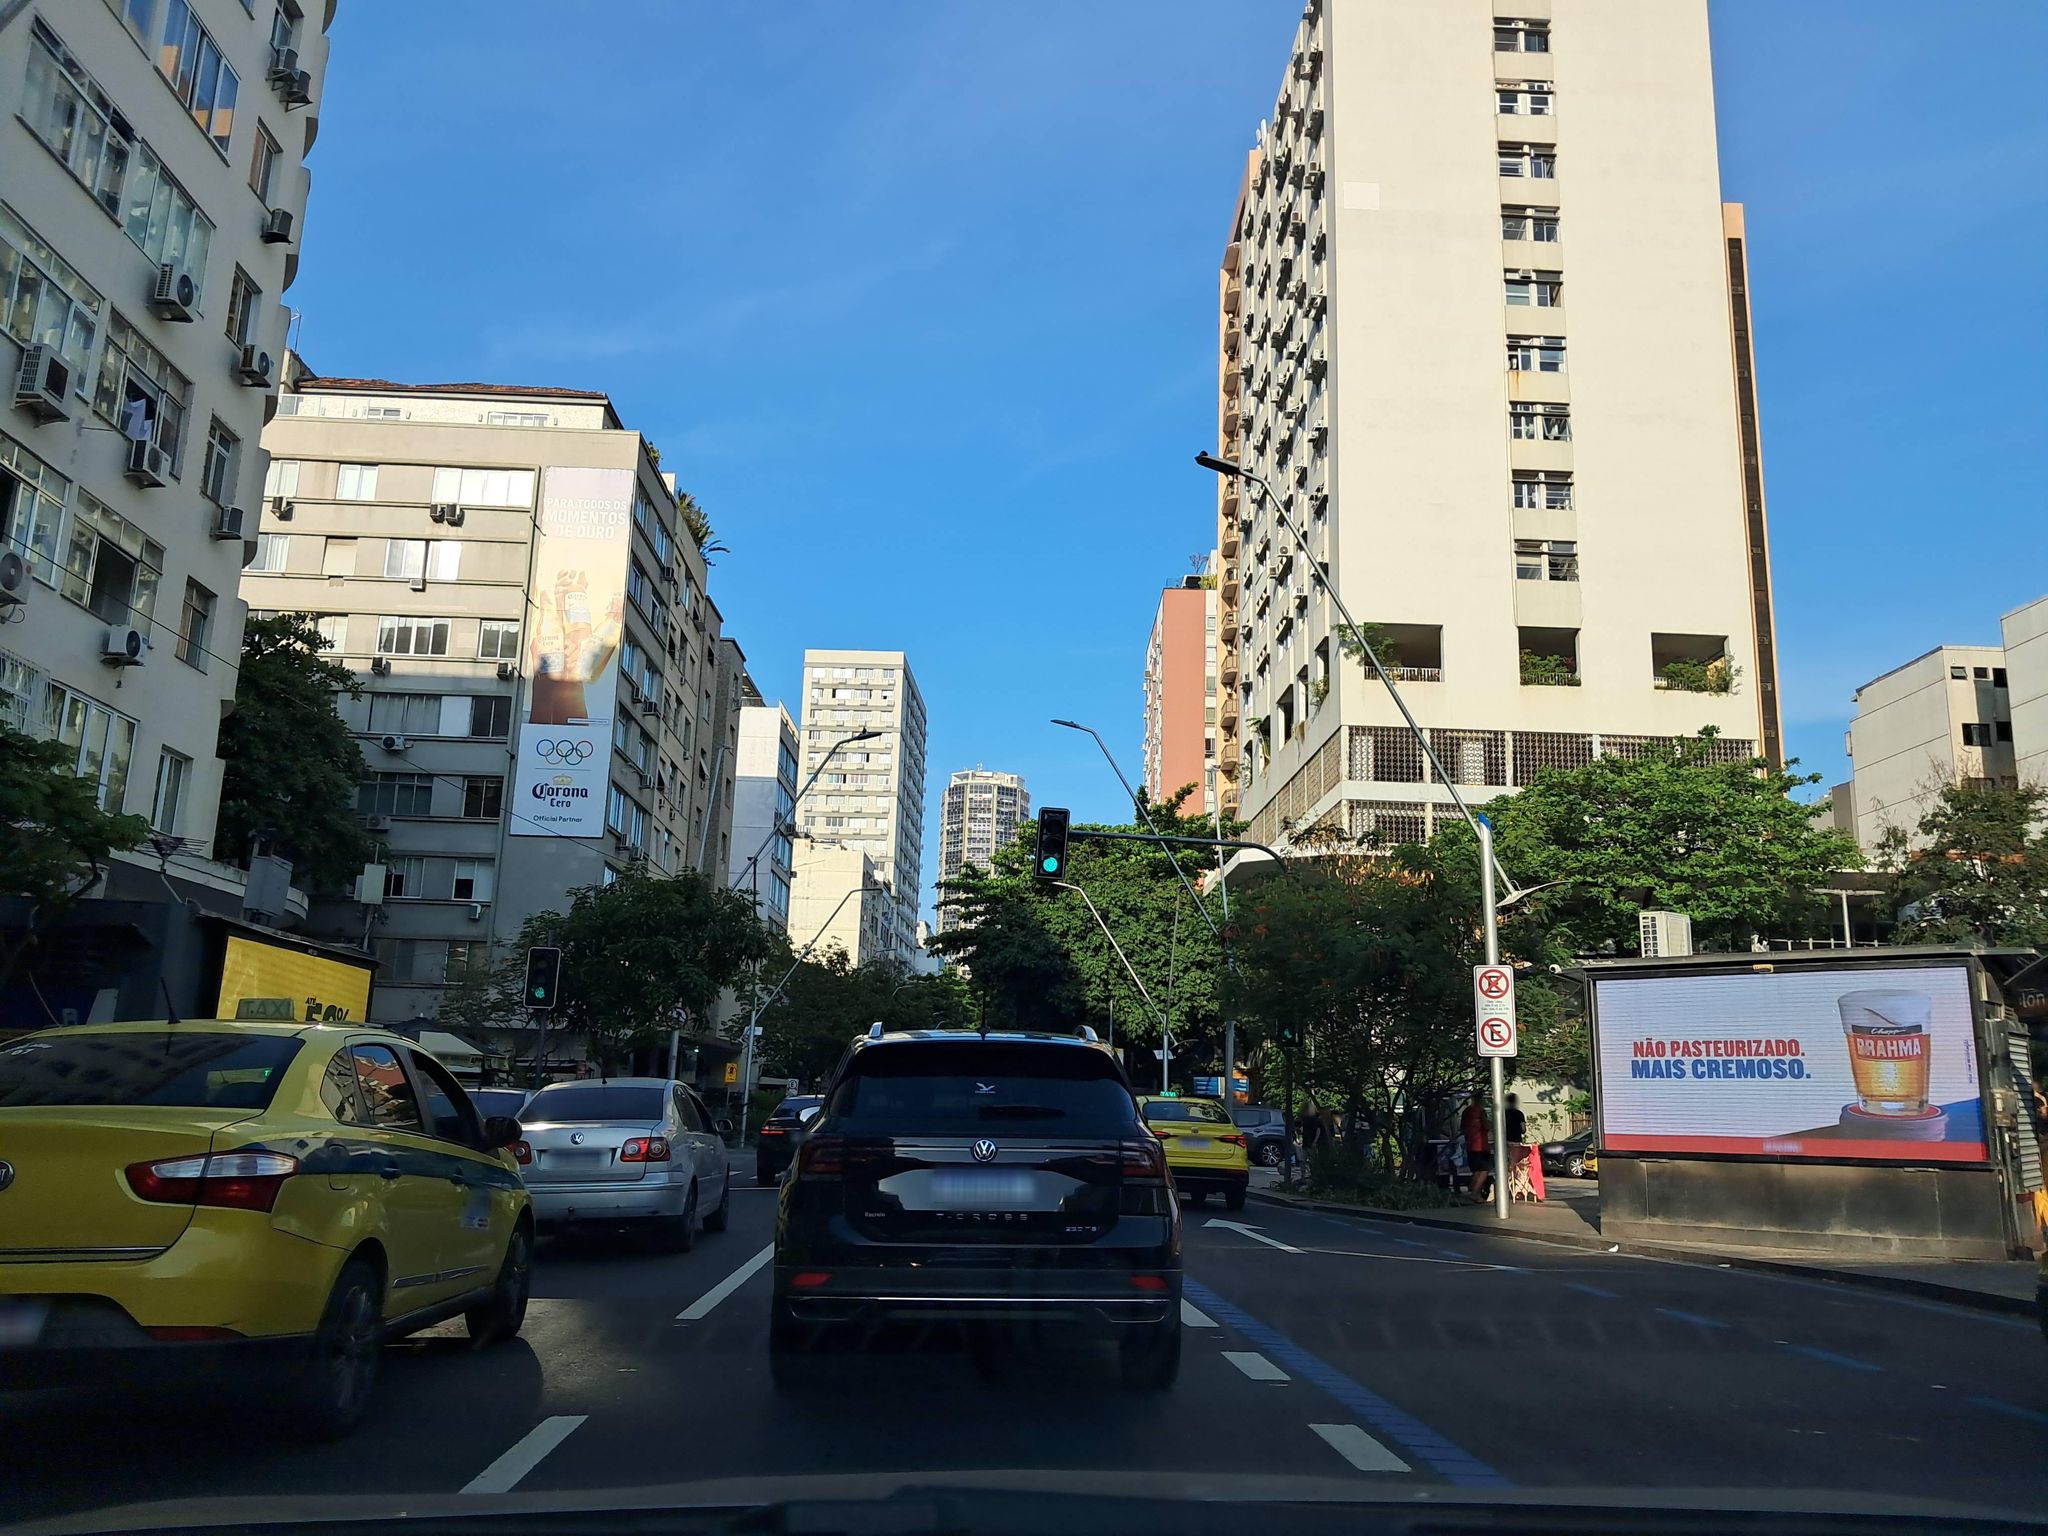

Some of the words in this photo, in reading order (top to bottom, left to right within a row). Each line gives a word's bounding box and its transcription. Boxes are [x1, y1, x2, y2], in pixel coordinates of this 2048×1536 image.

[547, 498, 574, 508] PARA
[577, 500, 610, 510] TODOS
[613, 500, 627, 511] OS
[545, 509, 626, 525] MOMENTOS
[557, 525, 573, 537] DE
[577, 526, 615, 539] OURO
[532, 782, 588, 801] Corona
[550, 798, 571, 808] Cero
[559, 815, 583, 823] Partner
[242, 1001, 292, 1017] TAXI
[1633, 1038, 1666, 1058] NÃO
[1670, 1039, 1806, 1058] PASTEURIZADO.
[1857, 1038, 1921, 1057] BRAHMA
[1631, 1059, 1686, 1079] MAIS
[1691, 1059, 1812, 1080] CREMOSO.
